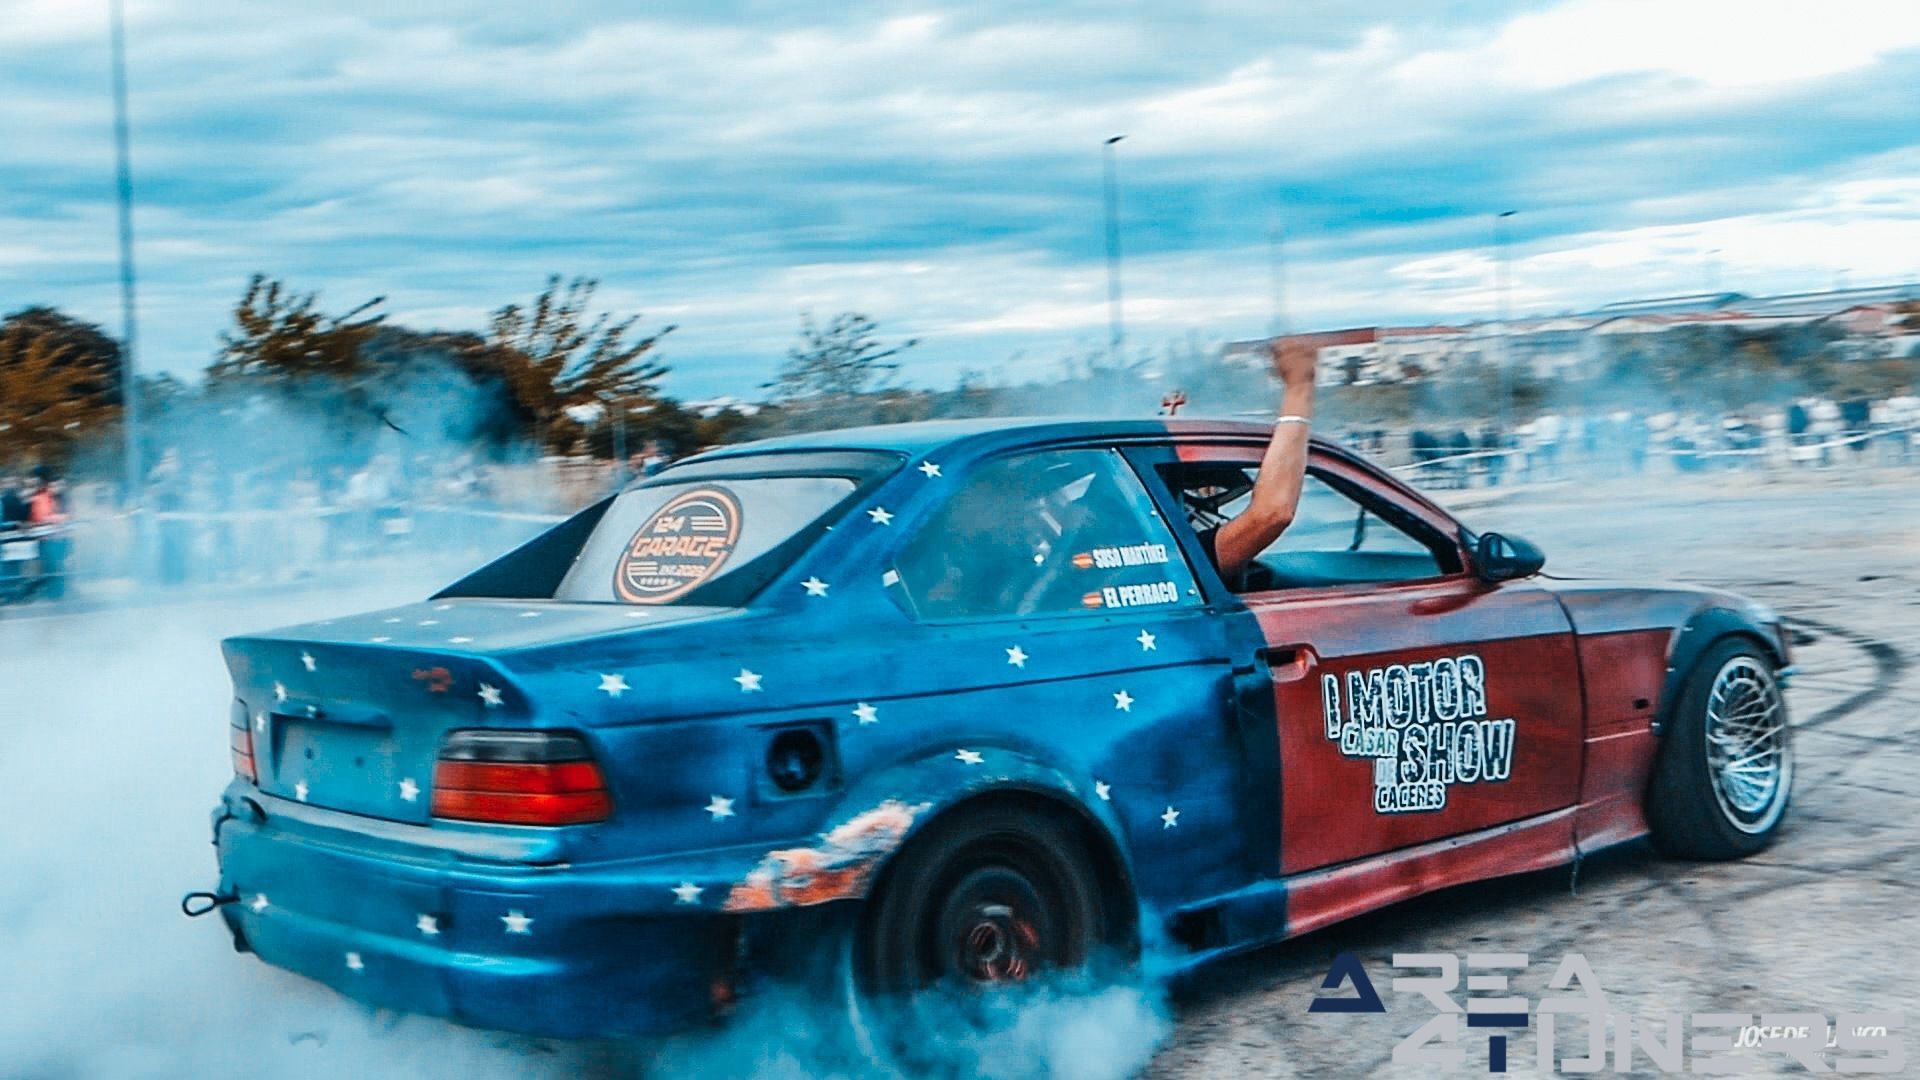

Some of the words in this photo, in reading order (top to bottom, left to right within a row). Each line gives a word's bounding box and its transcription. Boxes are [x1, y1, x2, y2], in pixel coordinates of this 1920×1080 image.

[632, 535, 727, 557] GARAGE
[1093, 547, 1122, 568] SUSO
[1120, 542, 1168, 565] MARTÍNEZ
[1103, 587, 1121, 608] EL
[1118, 581, 1178, 606] PERRACO
[1322, 673, 1341, 738] I
[1347, 654, 1487, 732] MOTOR
[1342, 722, 1398, 757] CASAR
[1401, 718, 1515, 784] SHOW
[1376, 782, 1445, 812] CACERES
